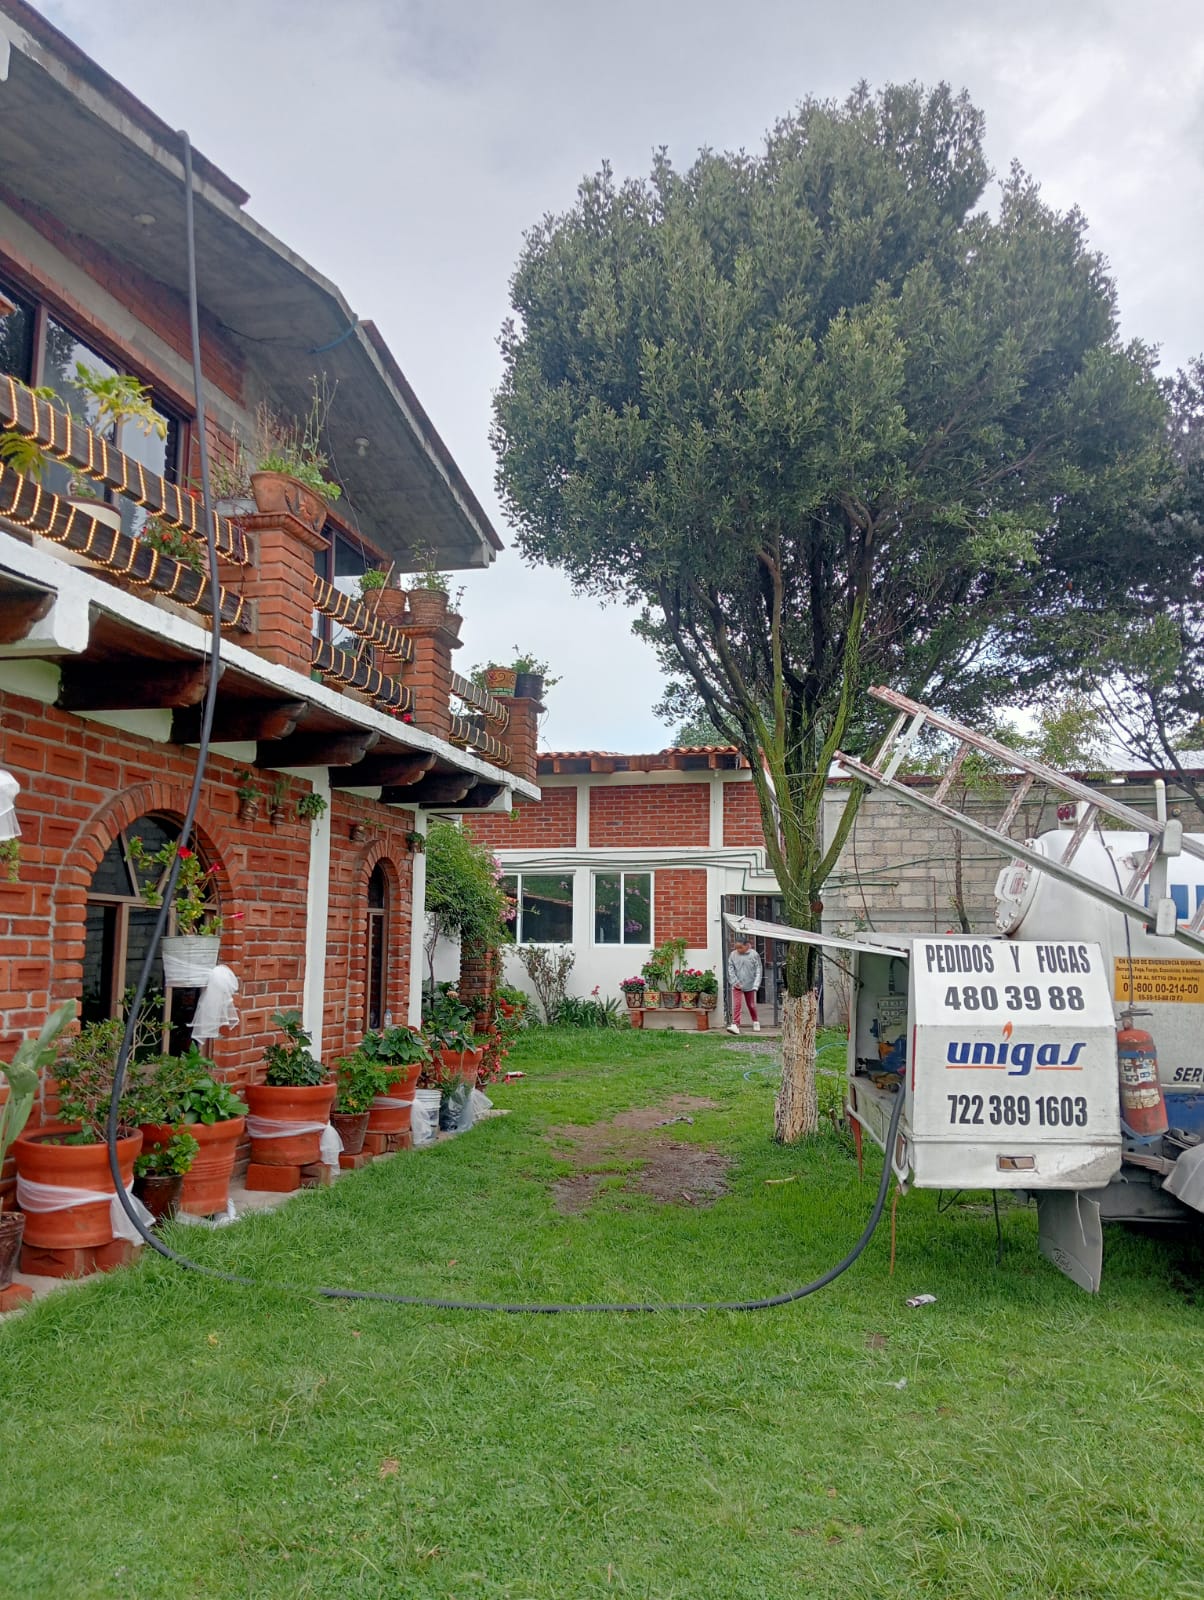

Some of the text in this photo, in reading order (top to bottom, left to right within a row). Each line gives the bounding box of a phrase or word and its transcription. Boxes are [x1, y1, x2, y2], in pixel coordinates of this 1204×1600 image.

[925, 944, 1091, 974] PEDIDOS Y FUGAS
[943, 985, 1085, 1011] 480 39 88
[1155, 983, 1199, 994] 00-214-00
[946, 1041, 1087, 1075] unigas
[1173, 1066, 1204, 1082] SER
[947, 1094, 1088, 1127] 722 389 1603
